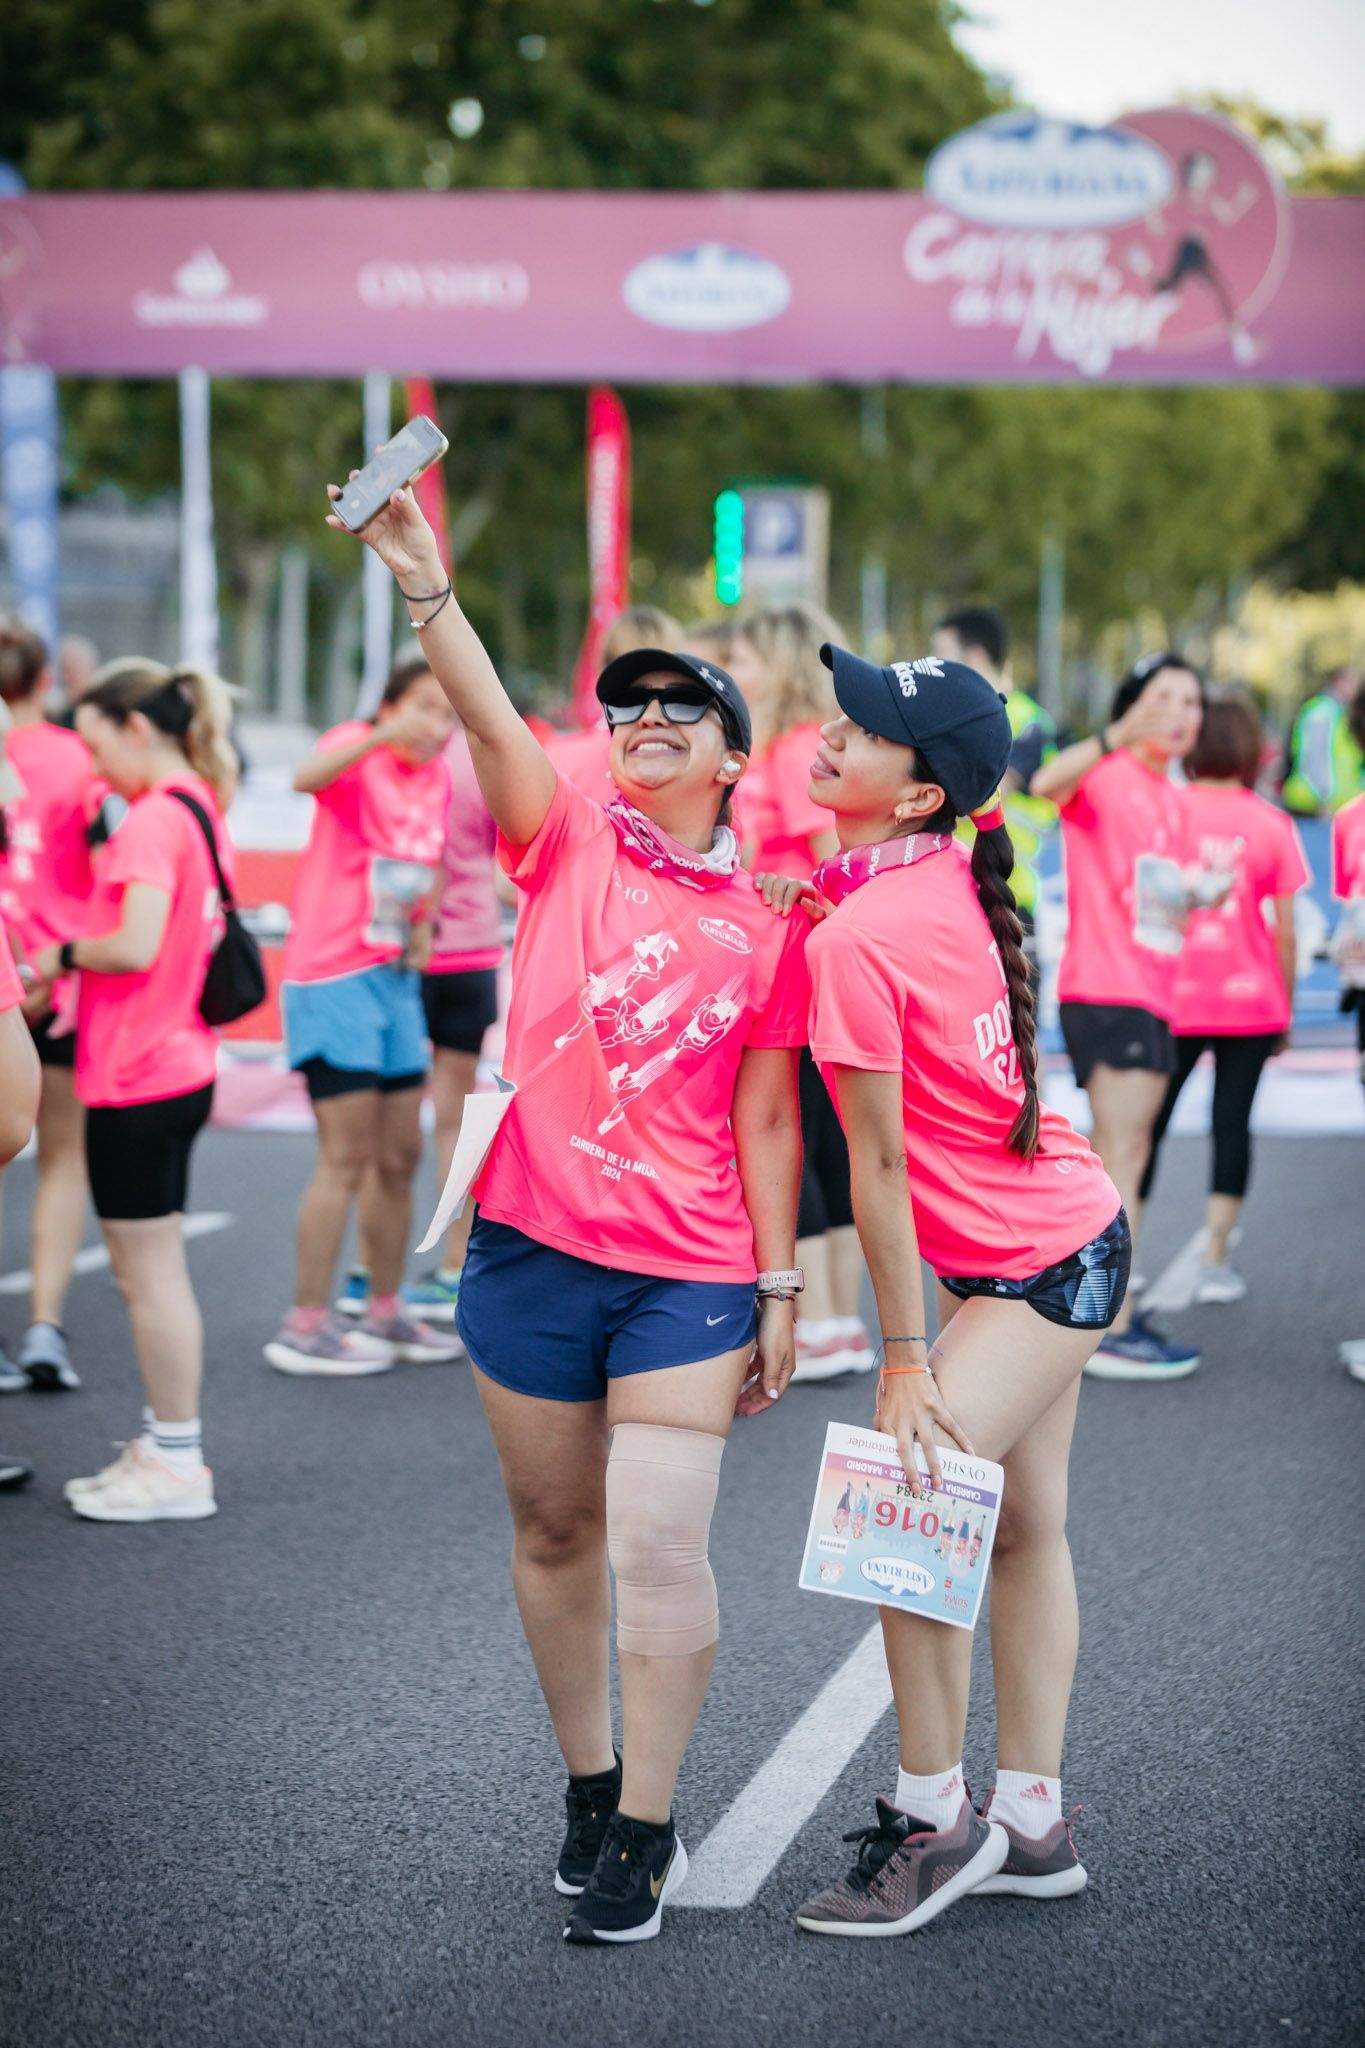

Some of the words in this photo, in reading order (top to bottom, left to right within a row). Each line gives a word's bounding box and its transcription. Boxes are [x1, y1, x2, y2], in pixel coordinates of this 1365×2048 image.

[569, 1134, 606, 1160] CARRERA
[606, 1151, 619, 1166] DE
[619, 1156, 631, 1171] LA
[600, 1163, 622, 1182] 2024
[846, 1459, 883, 1477] MADRID
[945, 1482, 982, 1501] CARRERA
[874, 1500, 940, 1538] 016
[866, 1561, 929, 1589] ASTURIANA
